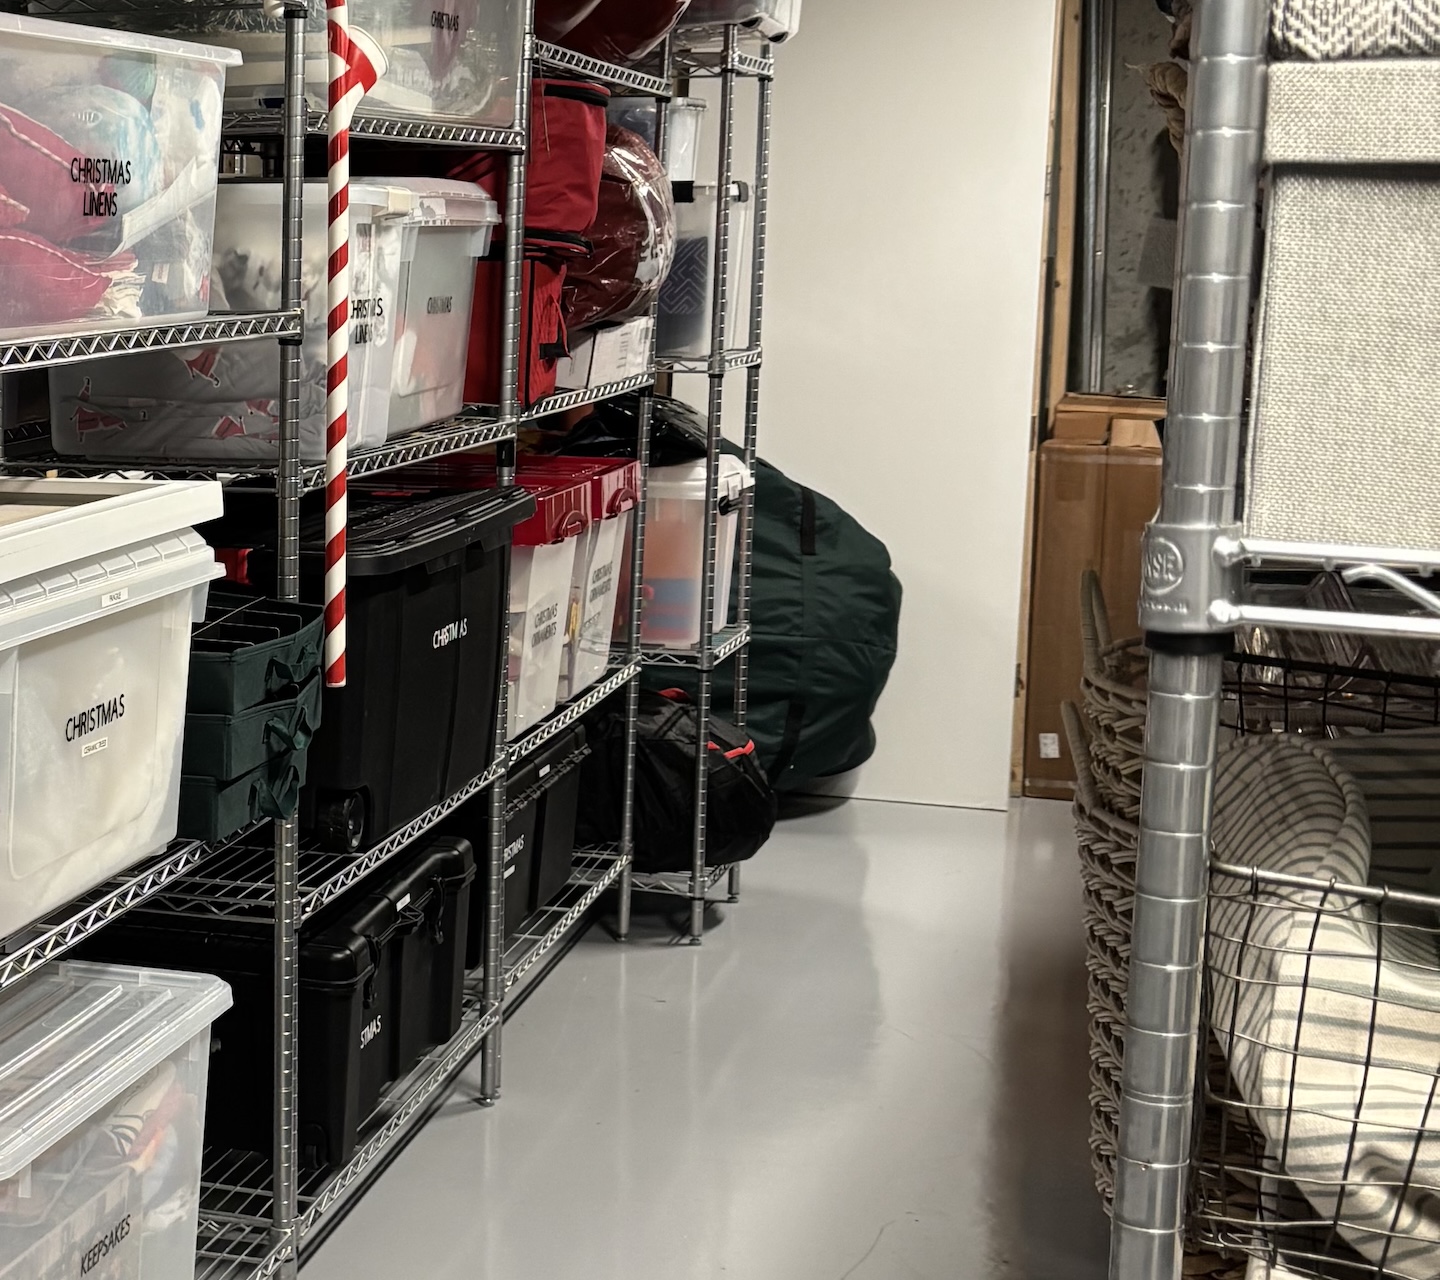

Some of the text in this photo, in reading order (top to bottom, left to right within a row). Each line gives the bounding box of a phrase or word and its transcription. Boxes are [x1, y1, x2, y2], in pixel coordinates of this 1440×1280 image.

[70, 157, 132, 185] CHRISTMAS
[82, 191, 118, 217] LINENS
[65, 693, 126, 742] CHRISTMAS
[80, 1213, 131, 1278] KEEPSAKES
